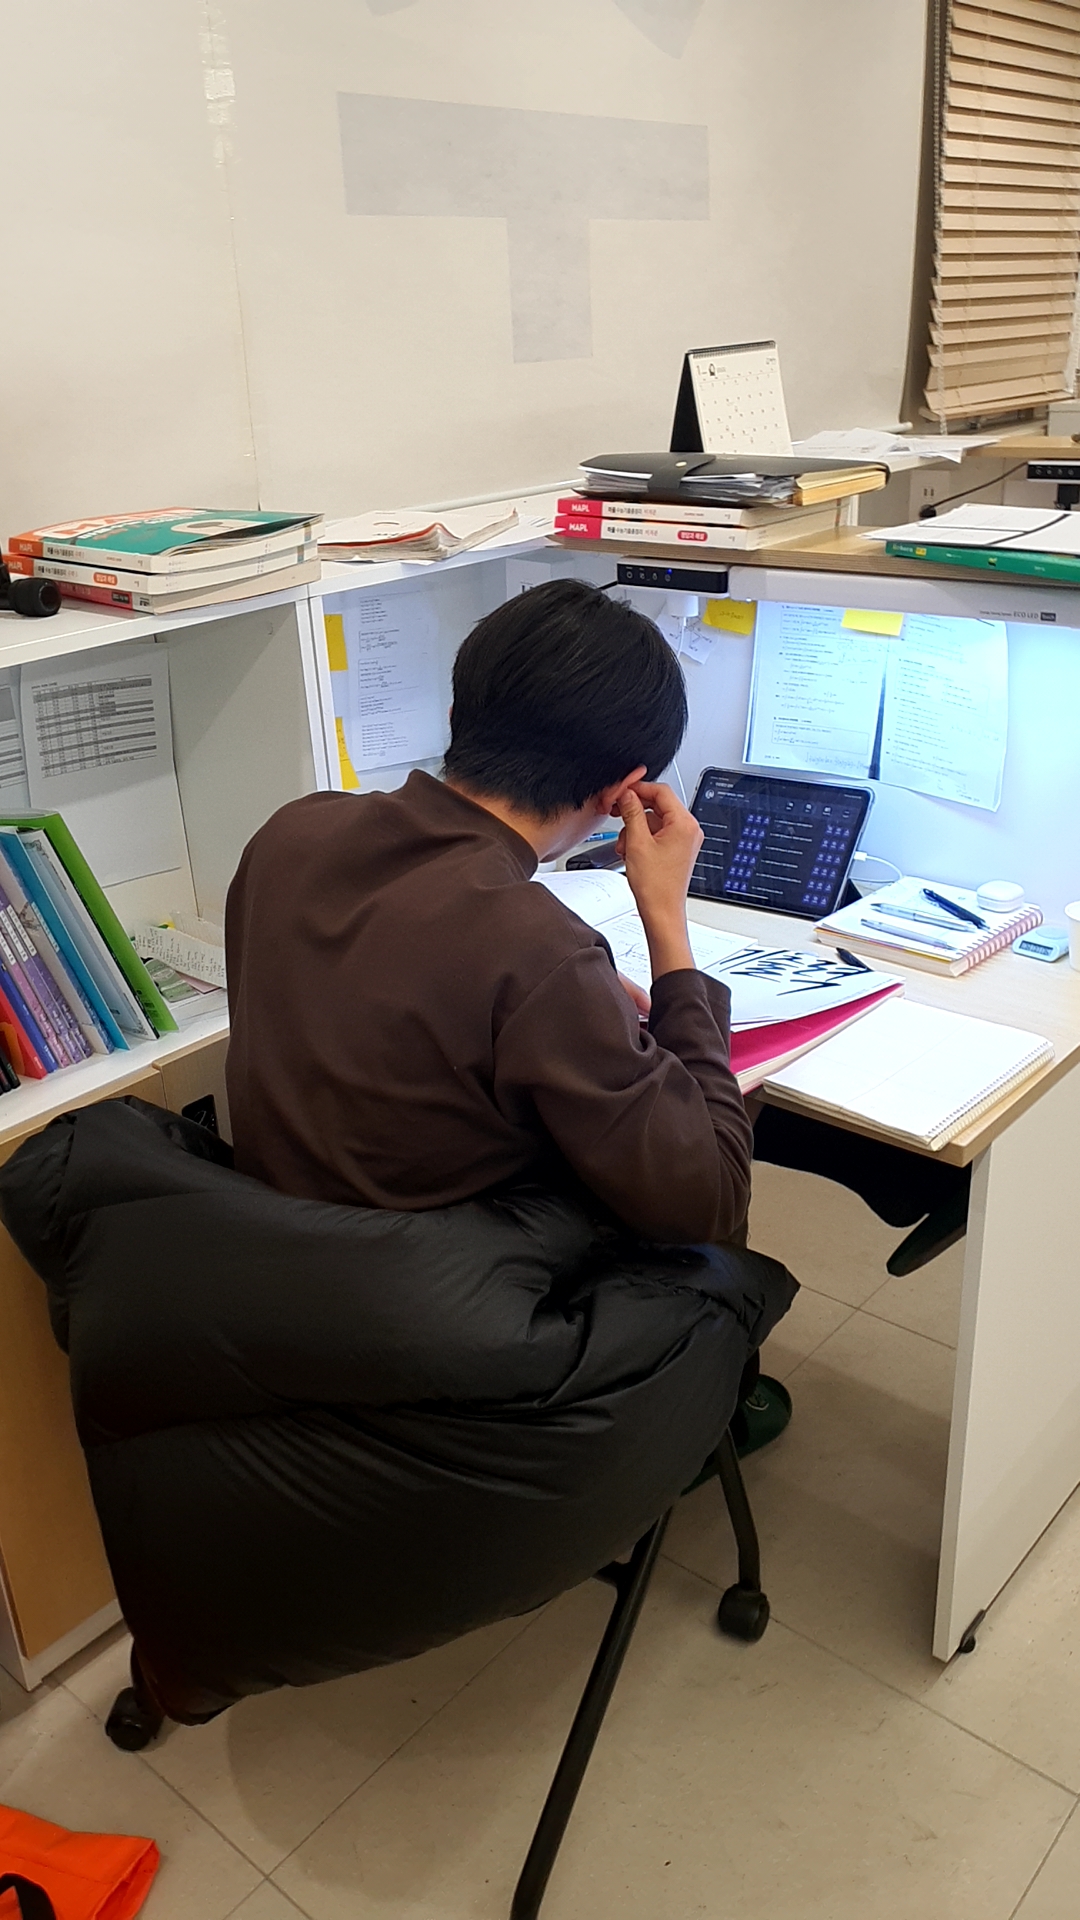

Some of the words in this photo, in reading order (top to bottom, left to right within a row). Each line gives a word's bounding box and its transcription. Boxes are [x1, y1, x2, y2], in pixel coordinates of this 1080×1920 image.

[571, 503, 590, 513] MAPL
[569, 522, 588, 532] MAPL
[19, 543, 33, 553] MAPL
